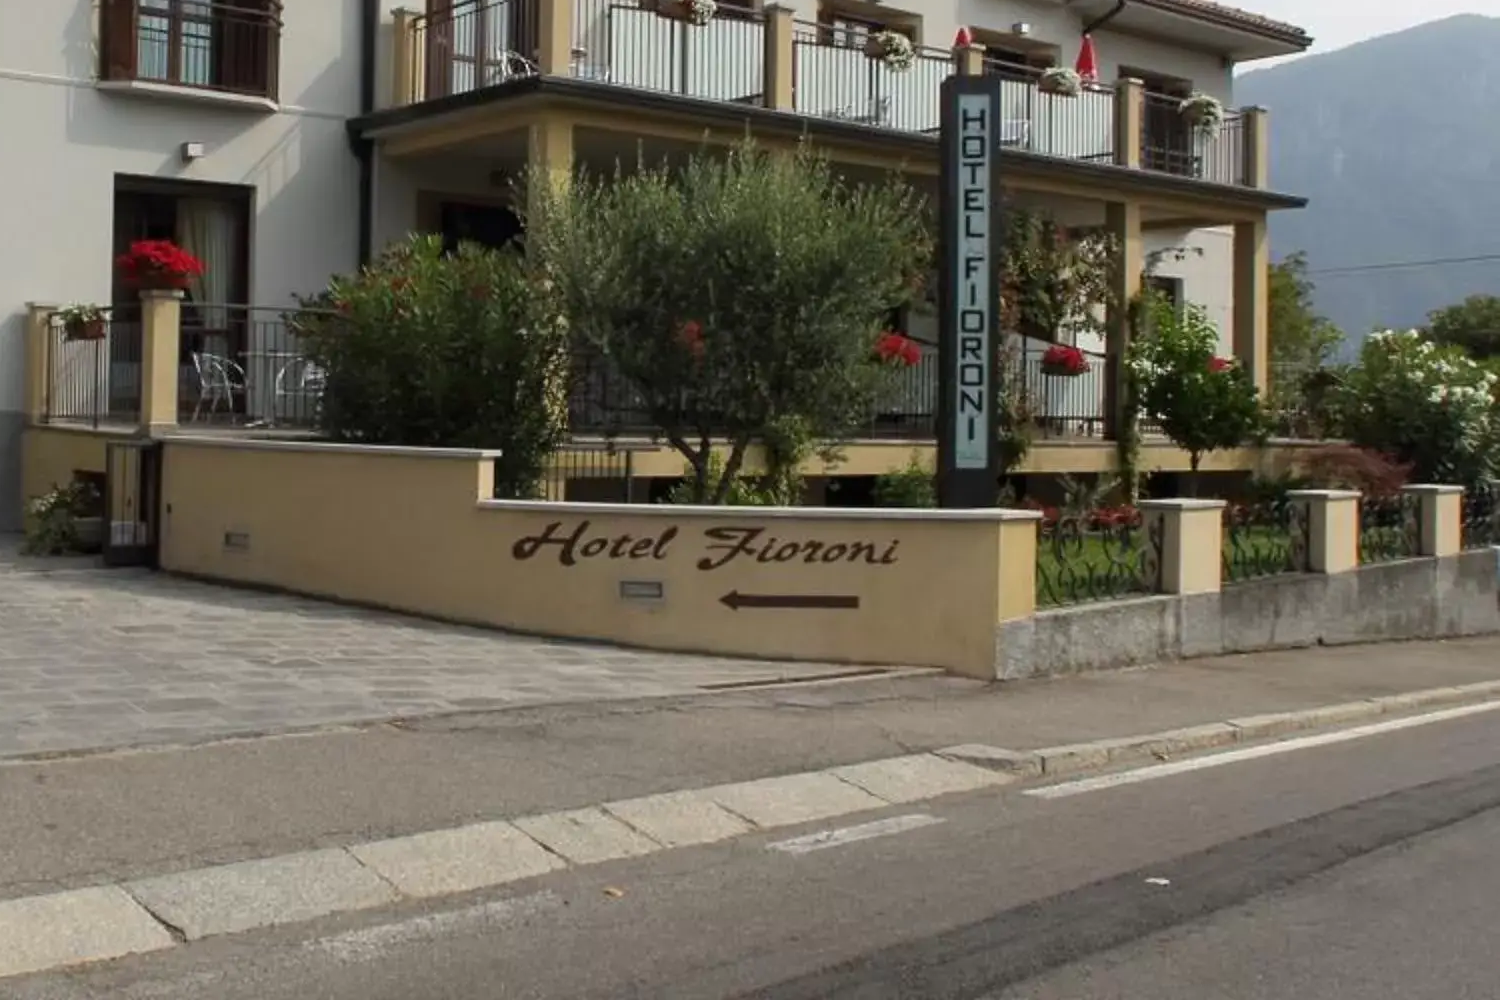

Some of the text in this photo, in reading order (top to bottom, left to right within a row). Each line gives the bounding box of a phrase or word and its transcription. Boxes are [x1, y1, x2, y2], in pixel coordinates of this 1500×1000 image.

[961, 107, 987, 239] HOTEL
[959, 256, 986, 443] FIORONI
[511, 519, 901, 572] Hotel Fioroni
